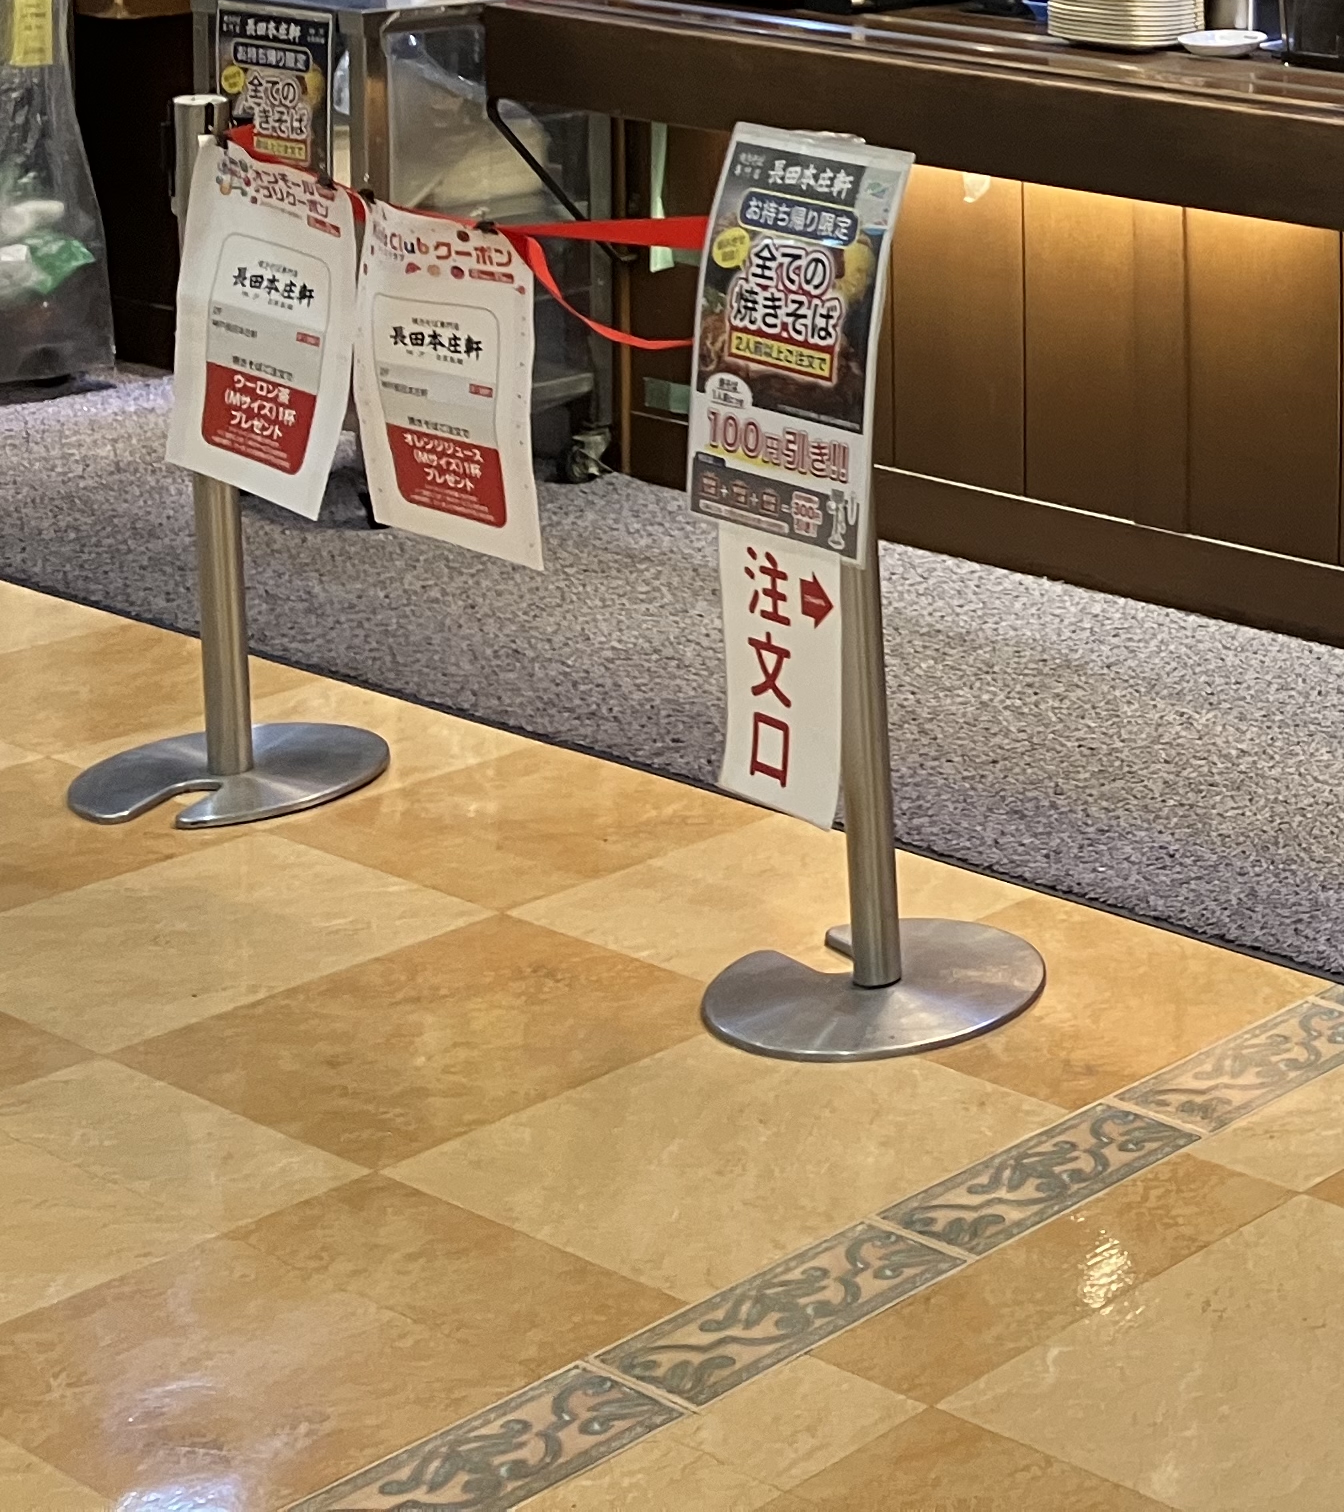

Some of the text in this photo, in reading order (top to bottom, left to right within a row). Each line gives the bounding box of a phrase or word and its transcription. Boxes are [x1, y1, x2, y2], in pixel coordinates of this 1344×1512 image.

[248, 74, 298, 108] 全ての
[255, 108, 309, 137] きそば
[767, 159, 855, 201] 長田本庄軒
[744, 195, 853, 242] お持ち帰り限定
[232, 266, 315, 309] 長田本庄軒
[750, 242, 829, 291] 全ての
[732, 286, 837, 341] 焼きそば
[389, 325, 485, 362] 長田本庄軒
[232, 373, 291, 406] ウーロン茶
[230, 410, 284, 441] プレゼント
[706, 408, 849, 485] 100円引き!!
[423, 467, 475, 492] プレゼント
[743, 545, 793, 789] 注文口
